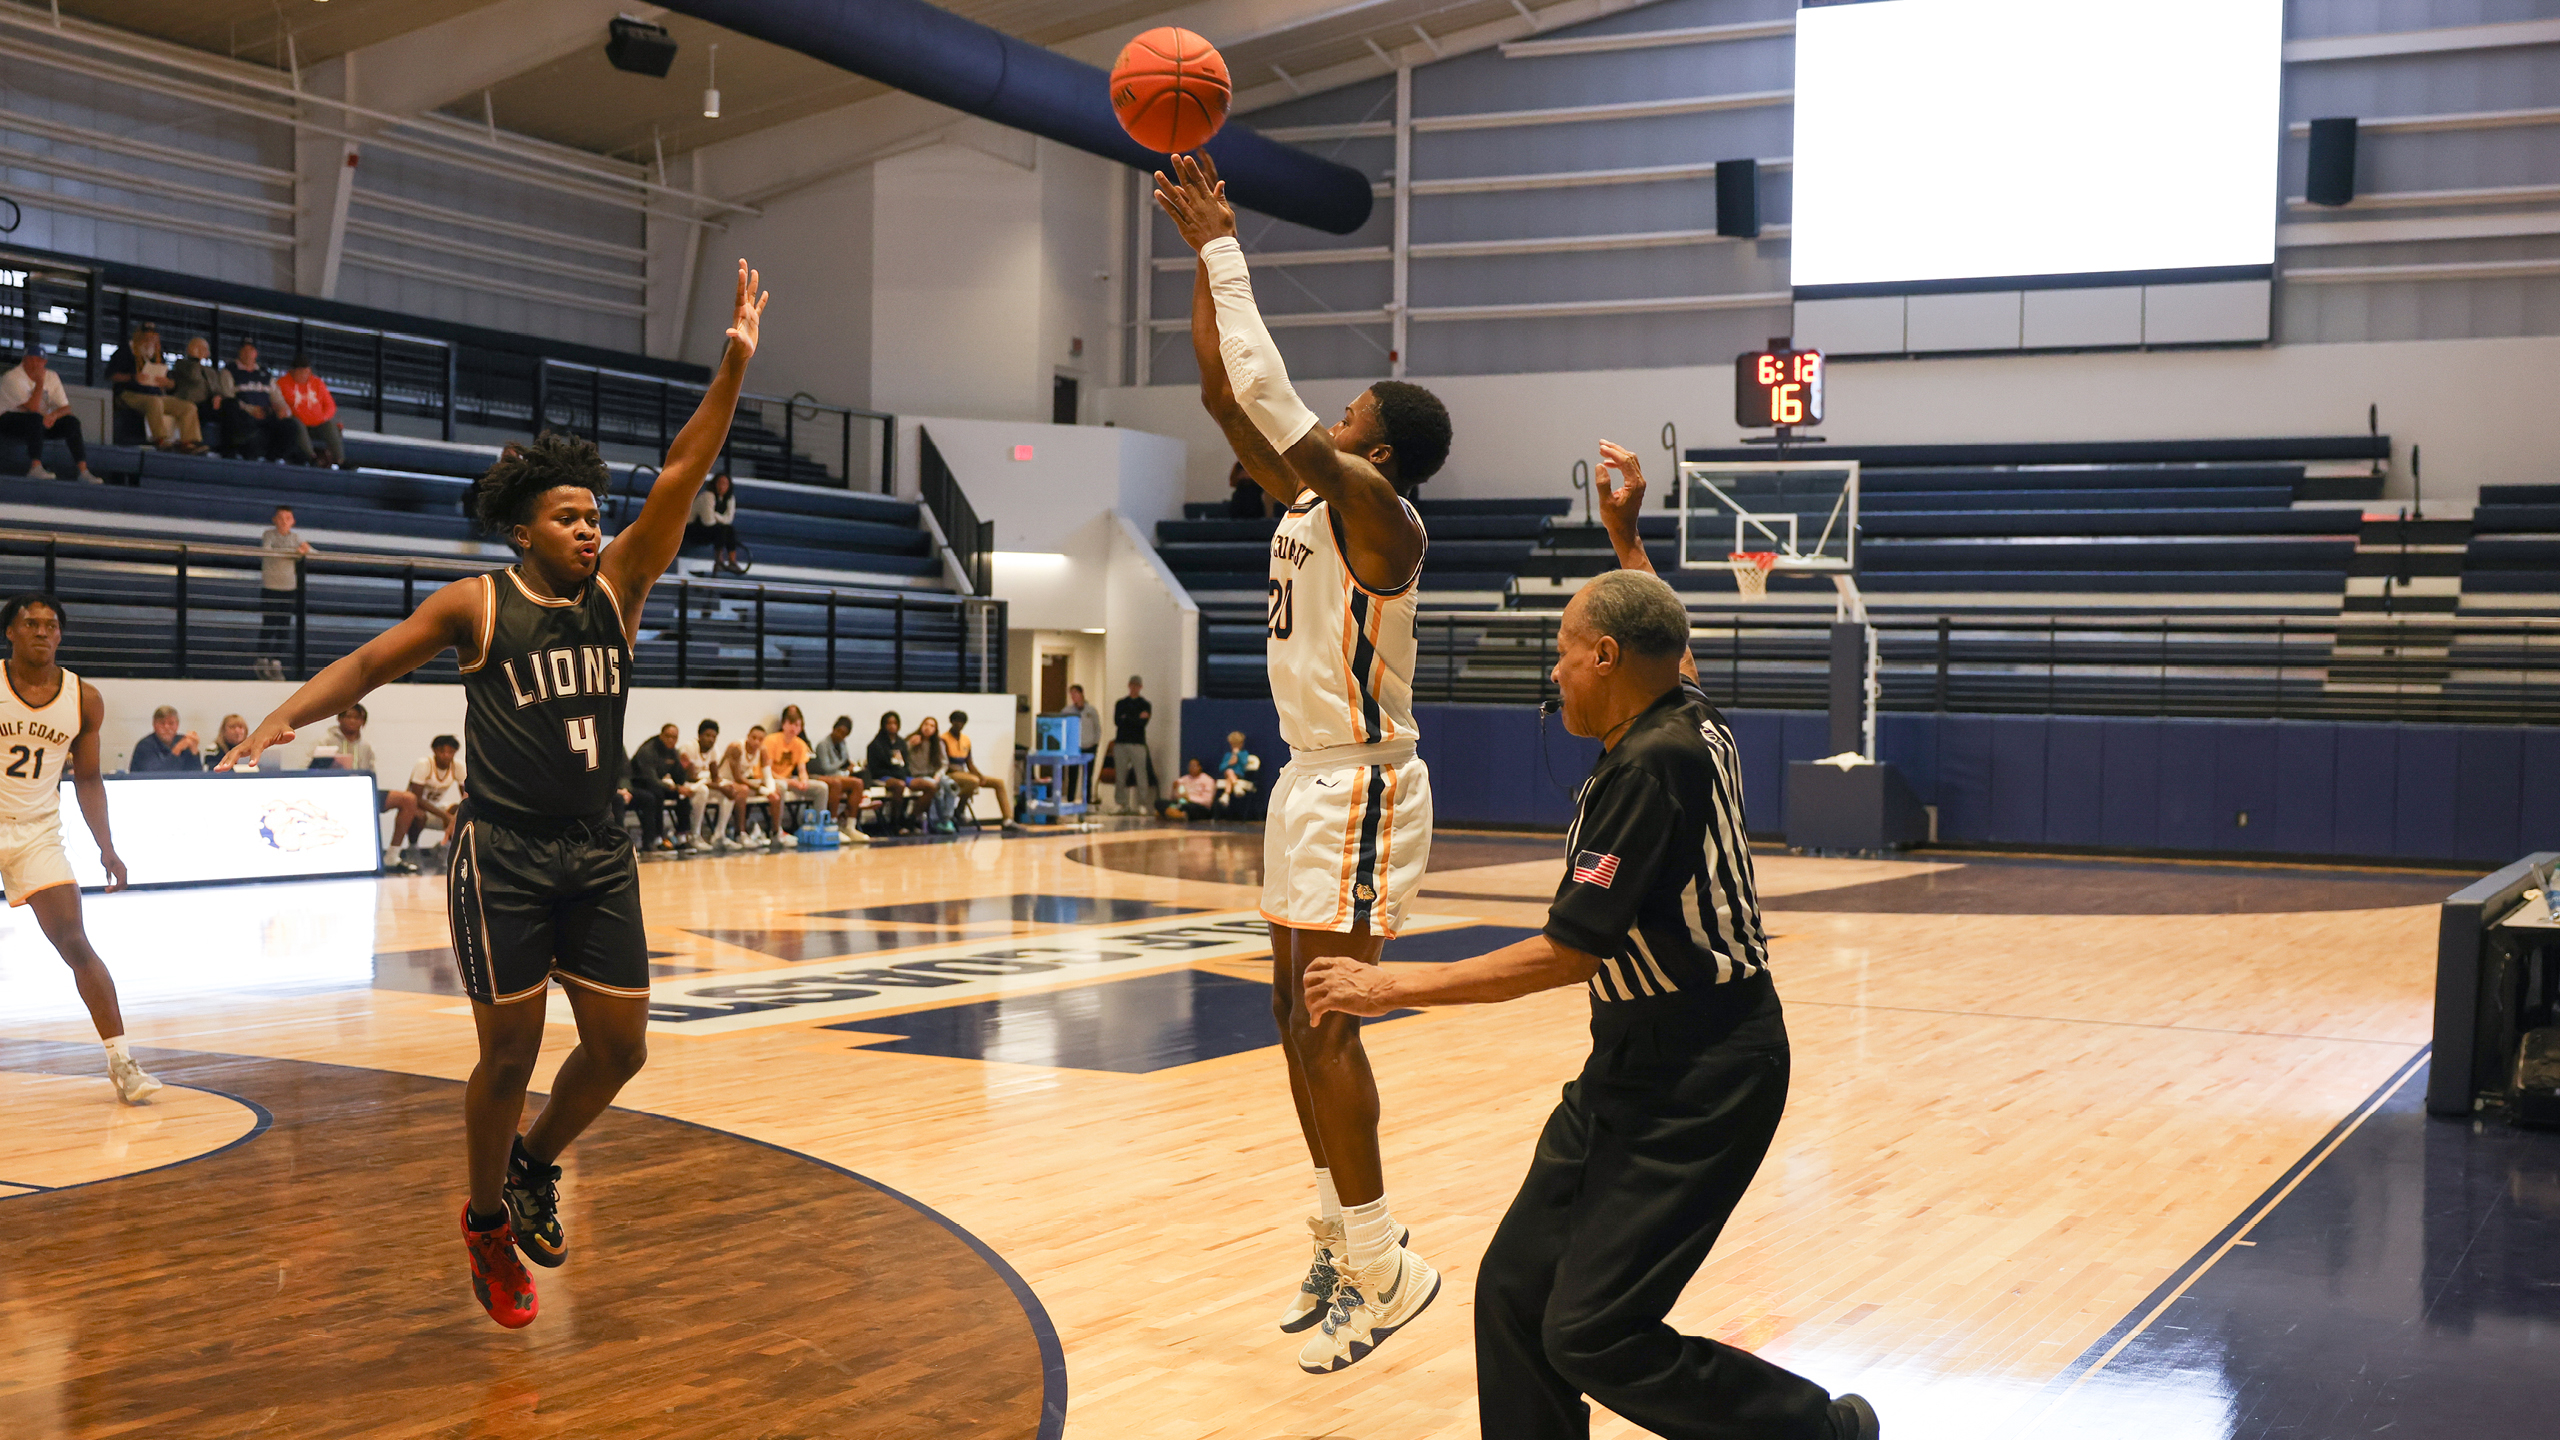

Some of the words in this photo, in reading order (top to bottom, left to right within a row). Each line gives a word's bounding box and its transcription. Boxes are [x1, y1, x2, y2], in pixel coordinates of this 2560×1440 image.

[1758, 353, 1820, 385] 6:12
[1771, 383, 1803, 423] 16
[1267, 578, 1293, 640] 20
[500, 644, 621, 710] LIONS
[0, 720, 23, 737] ULF
[28, 721, 70, 746] COAST
[563, 714, 600, 772] 4
[5, 744, 45, 779] 21
[1096, 920, 1270, 951] ULF
[647, 948, 1143, 1023] COAST
